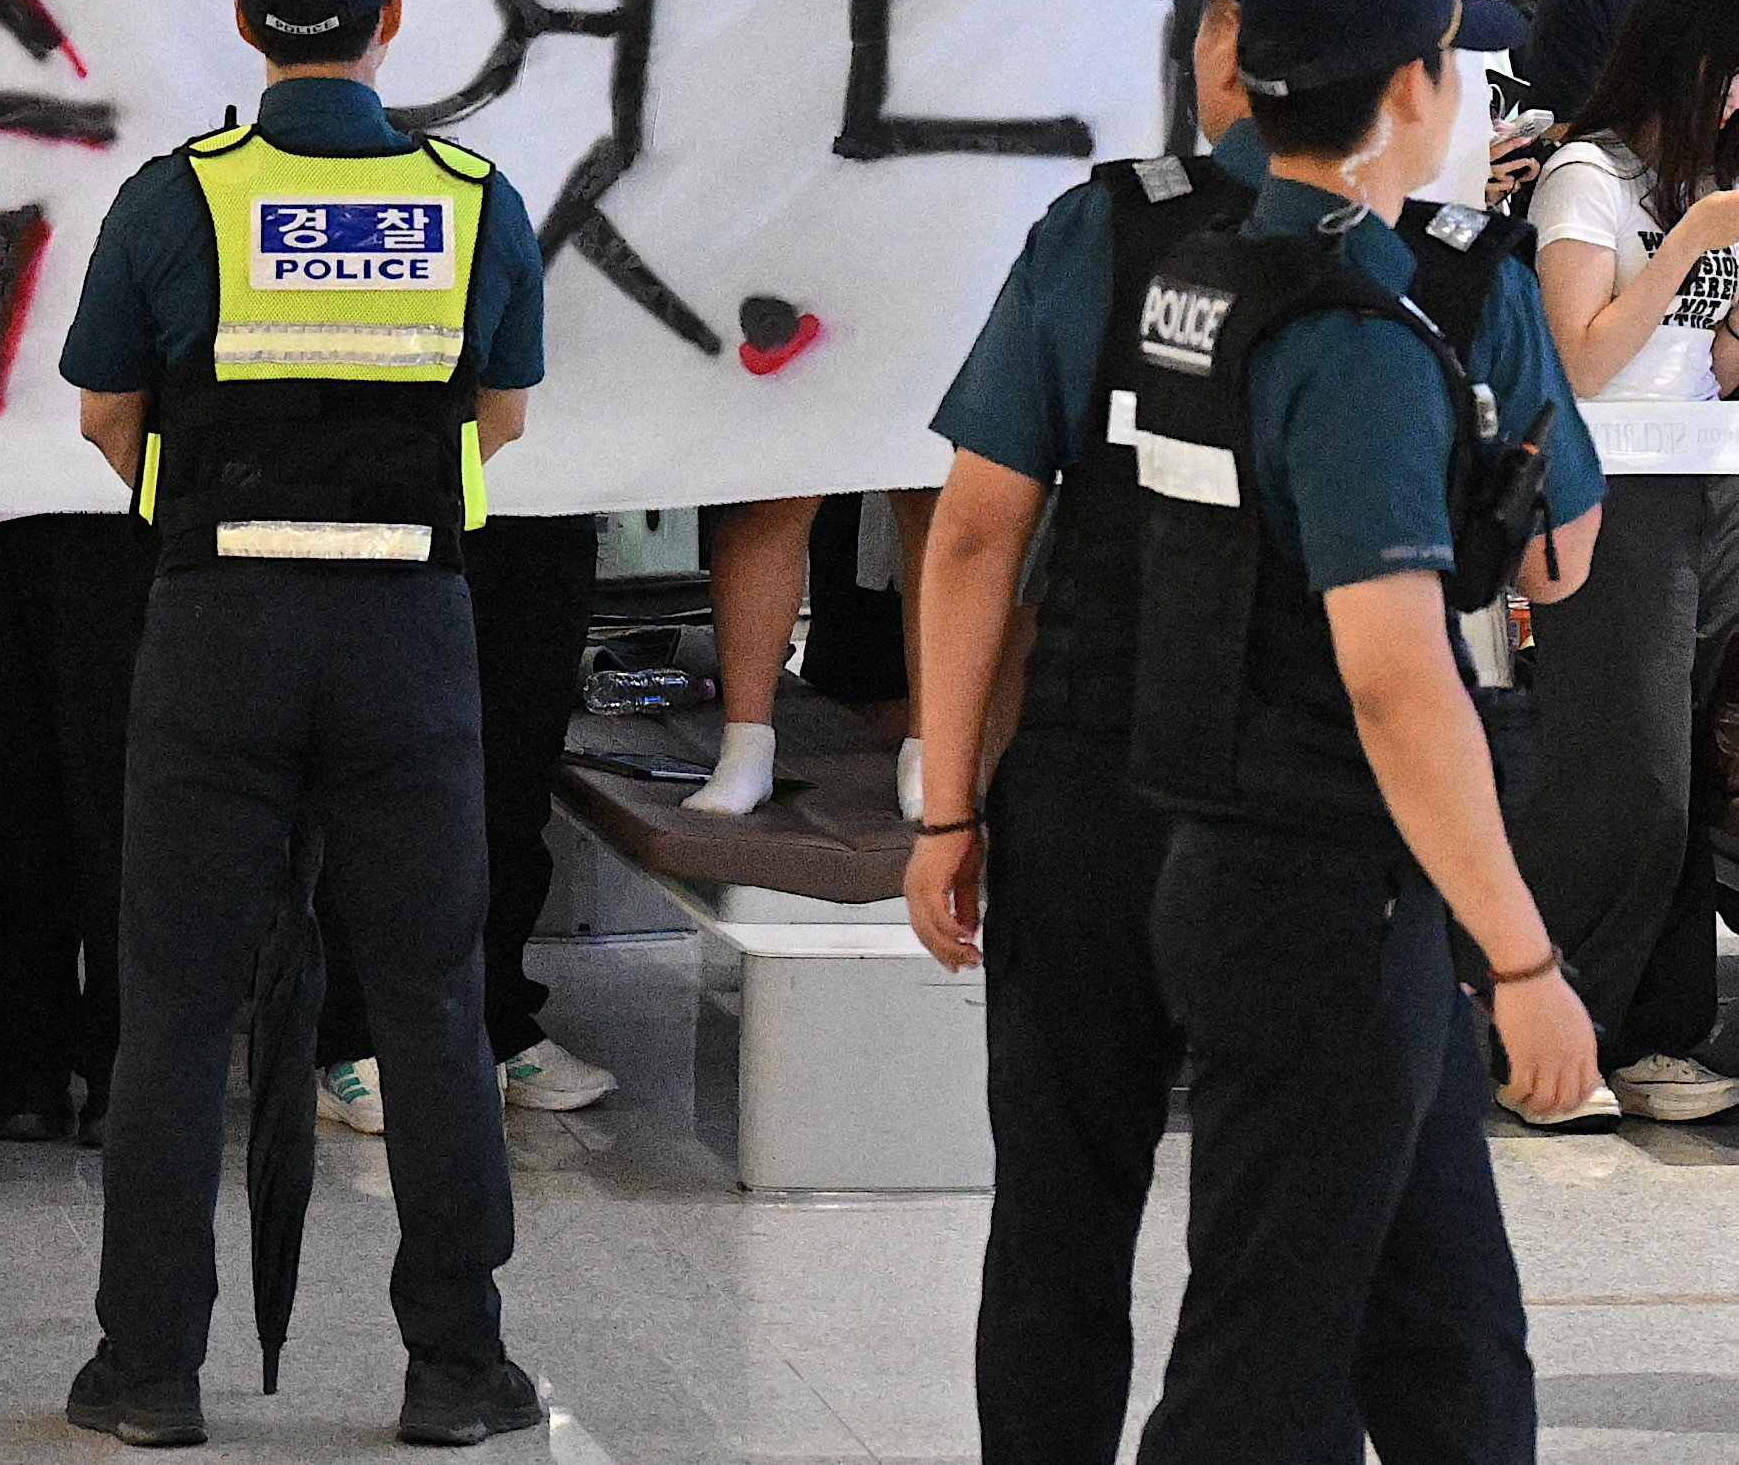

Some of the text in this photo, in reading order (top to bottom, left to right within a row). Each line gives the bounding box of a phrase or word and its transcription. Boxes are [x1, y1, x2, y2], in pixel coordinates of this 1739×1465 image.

[275, 20, 335, 34] POLICE
[275, 259, 430, 280] POLICE
[1141, 284, 1230, 351] POLICE
[1677, 298, 1722, 318] NOT
